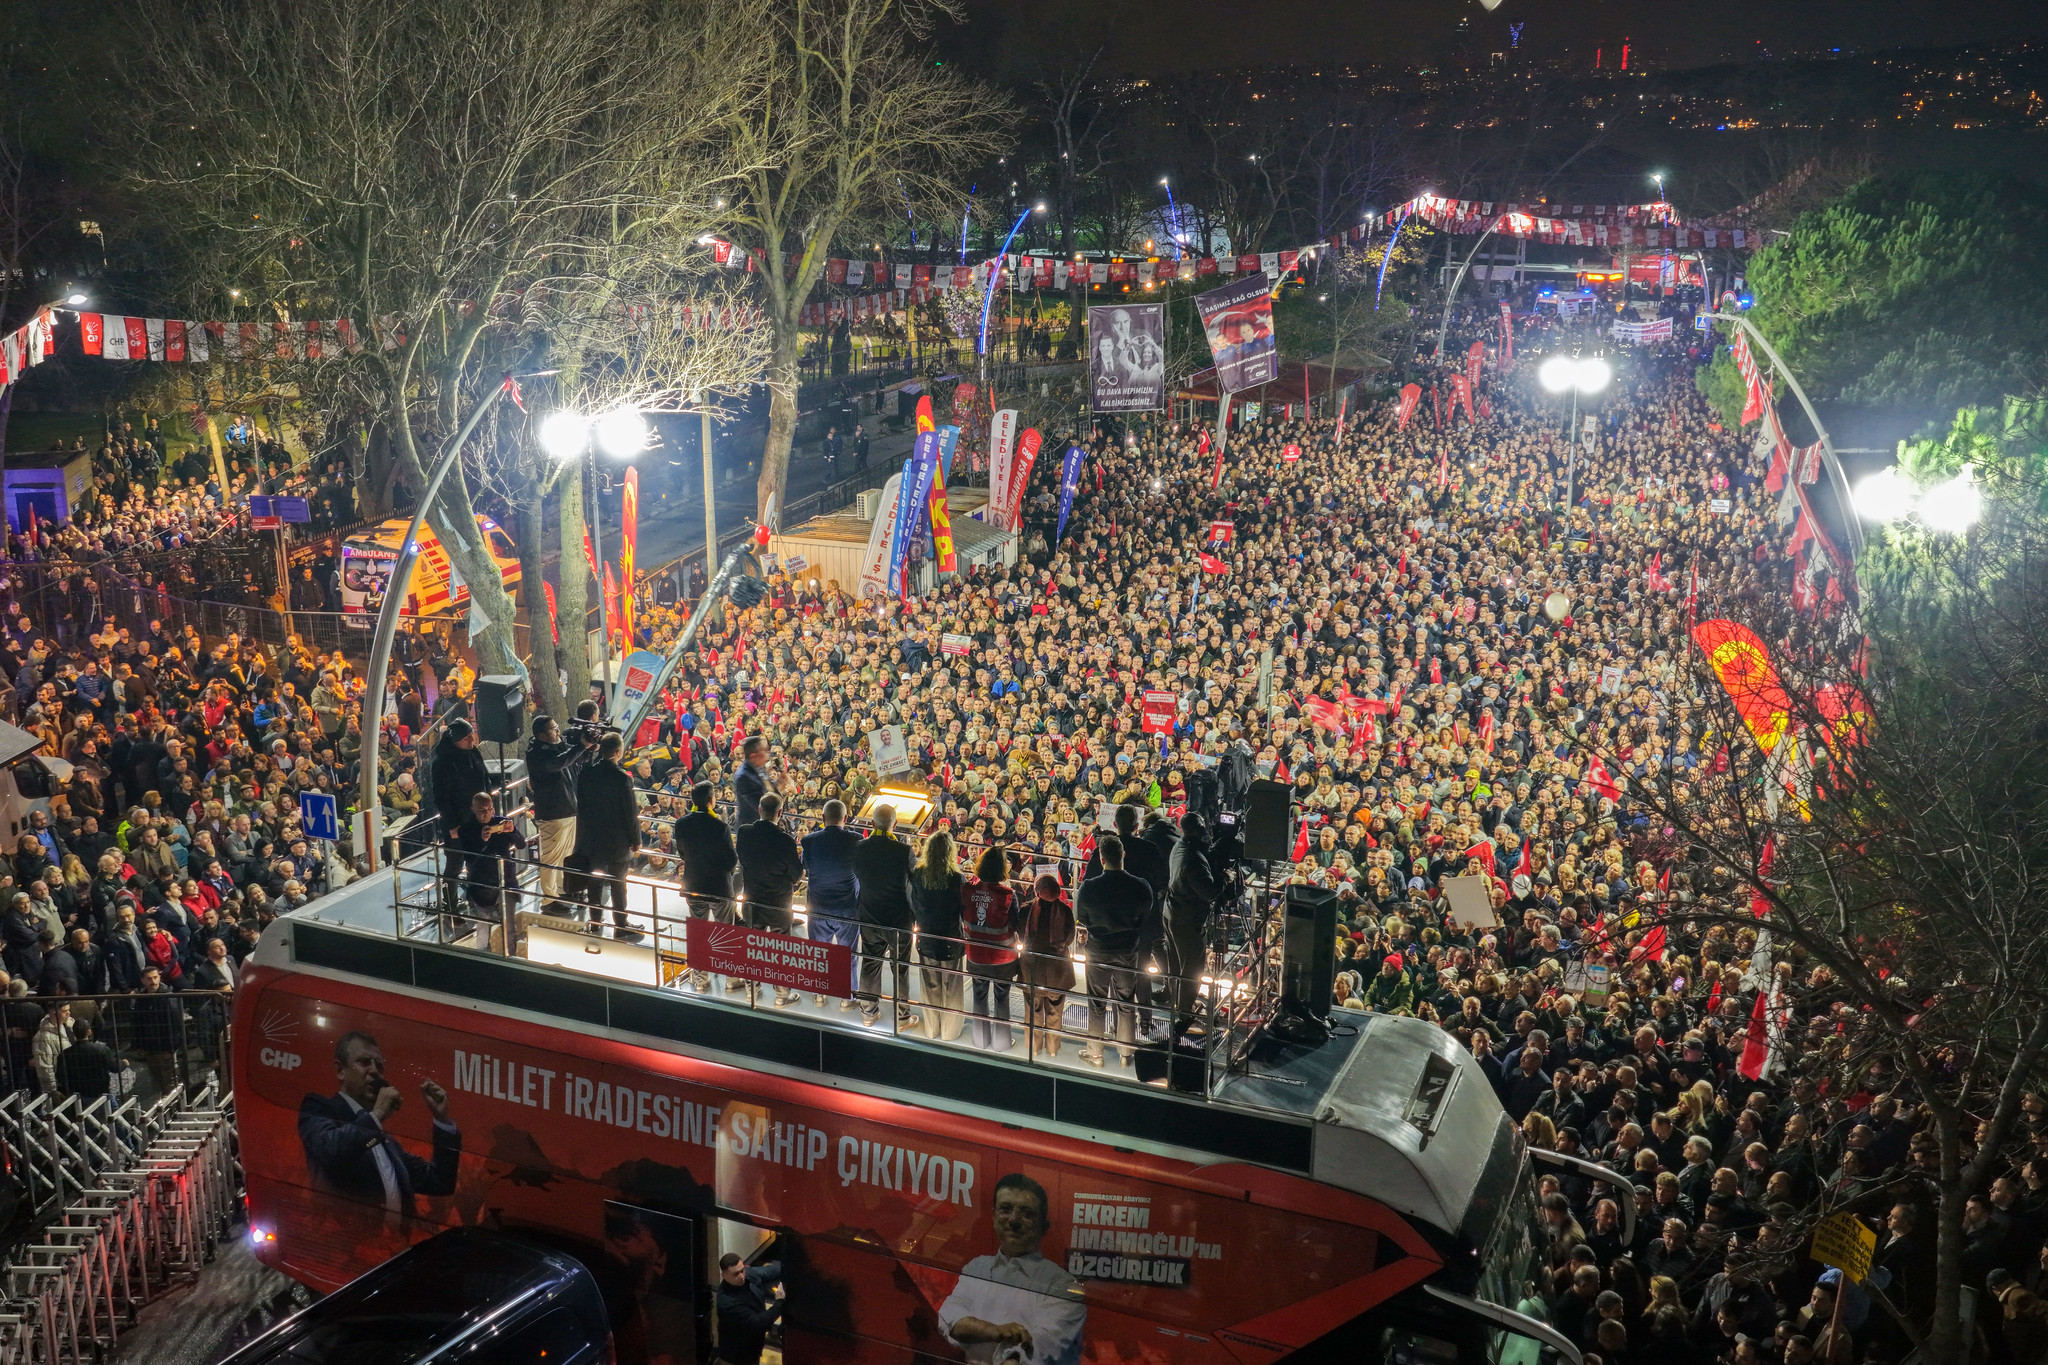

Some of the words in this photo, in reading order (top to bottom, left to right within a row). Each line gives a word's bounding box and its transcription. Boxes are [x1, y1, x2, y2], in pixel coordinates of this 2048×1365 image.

[1205, 301, 1231, 313] BAŞIMIZ
[1232, 295, 1245, 304] SAĞ
[1247, 287, 1269, 298] OLSUN
[110, 338, 124, 346] CHP
[999, 413, 1009, 481] BELEDİYE
[1022, 447, 1033, 460] CHP
[904, 463, 929, 537] BELEDİYE
[350, 549, 396, 558] AMBULANS
[873, 553, 882, 574] İŞ
[624, 688, 643, 700] CHP
[747, 934, 829, 959] CUMHURİYET
[709, 956, 762, 977] Türkiye'nin
[764, 967, 795, 983] Birinci
[798, 974, 829, 990] Partisi
[747, 949, 779, 964] HALK
[782, 956, 829, 974] PARTİSİ
[260, 1047, 302, 1071] CHP
[837, 1136, 974, 1208] ÇIKIYOR
[1074, 1192, 1123, 1202] CUMHURBAŞKANI
[1072, 1202, 1150, 1229] EKREM
[1070, 1225, 1222, 1260] İMAMOĞLU'NA
[1068, 1252, 1185, 1284] ÖZGÜRLÜK
